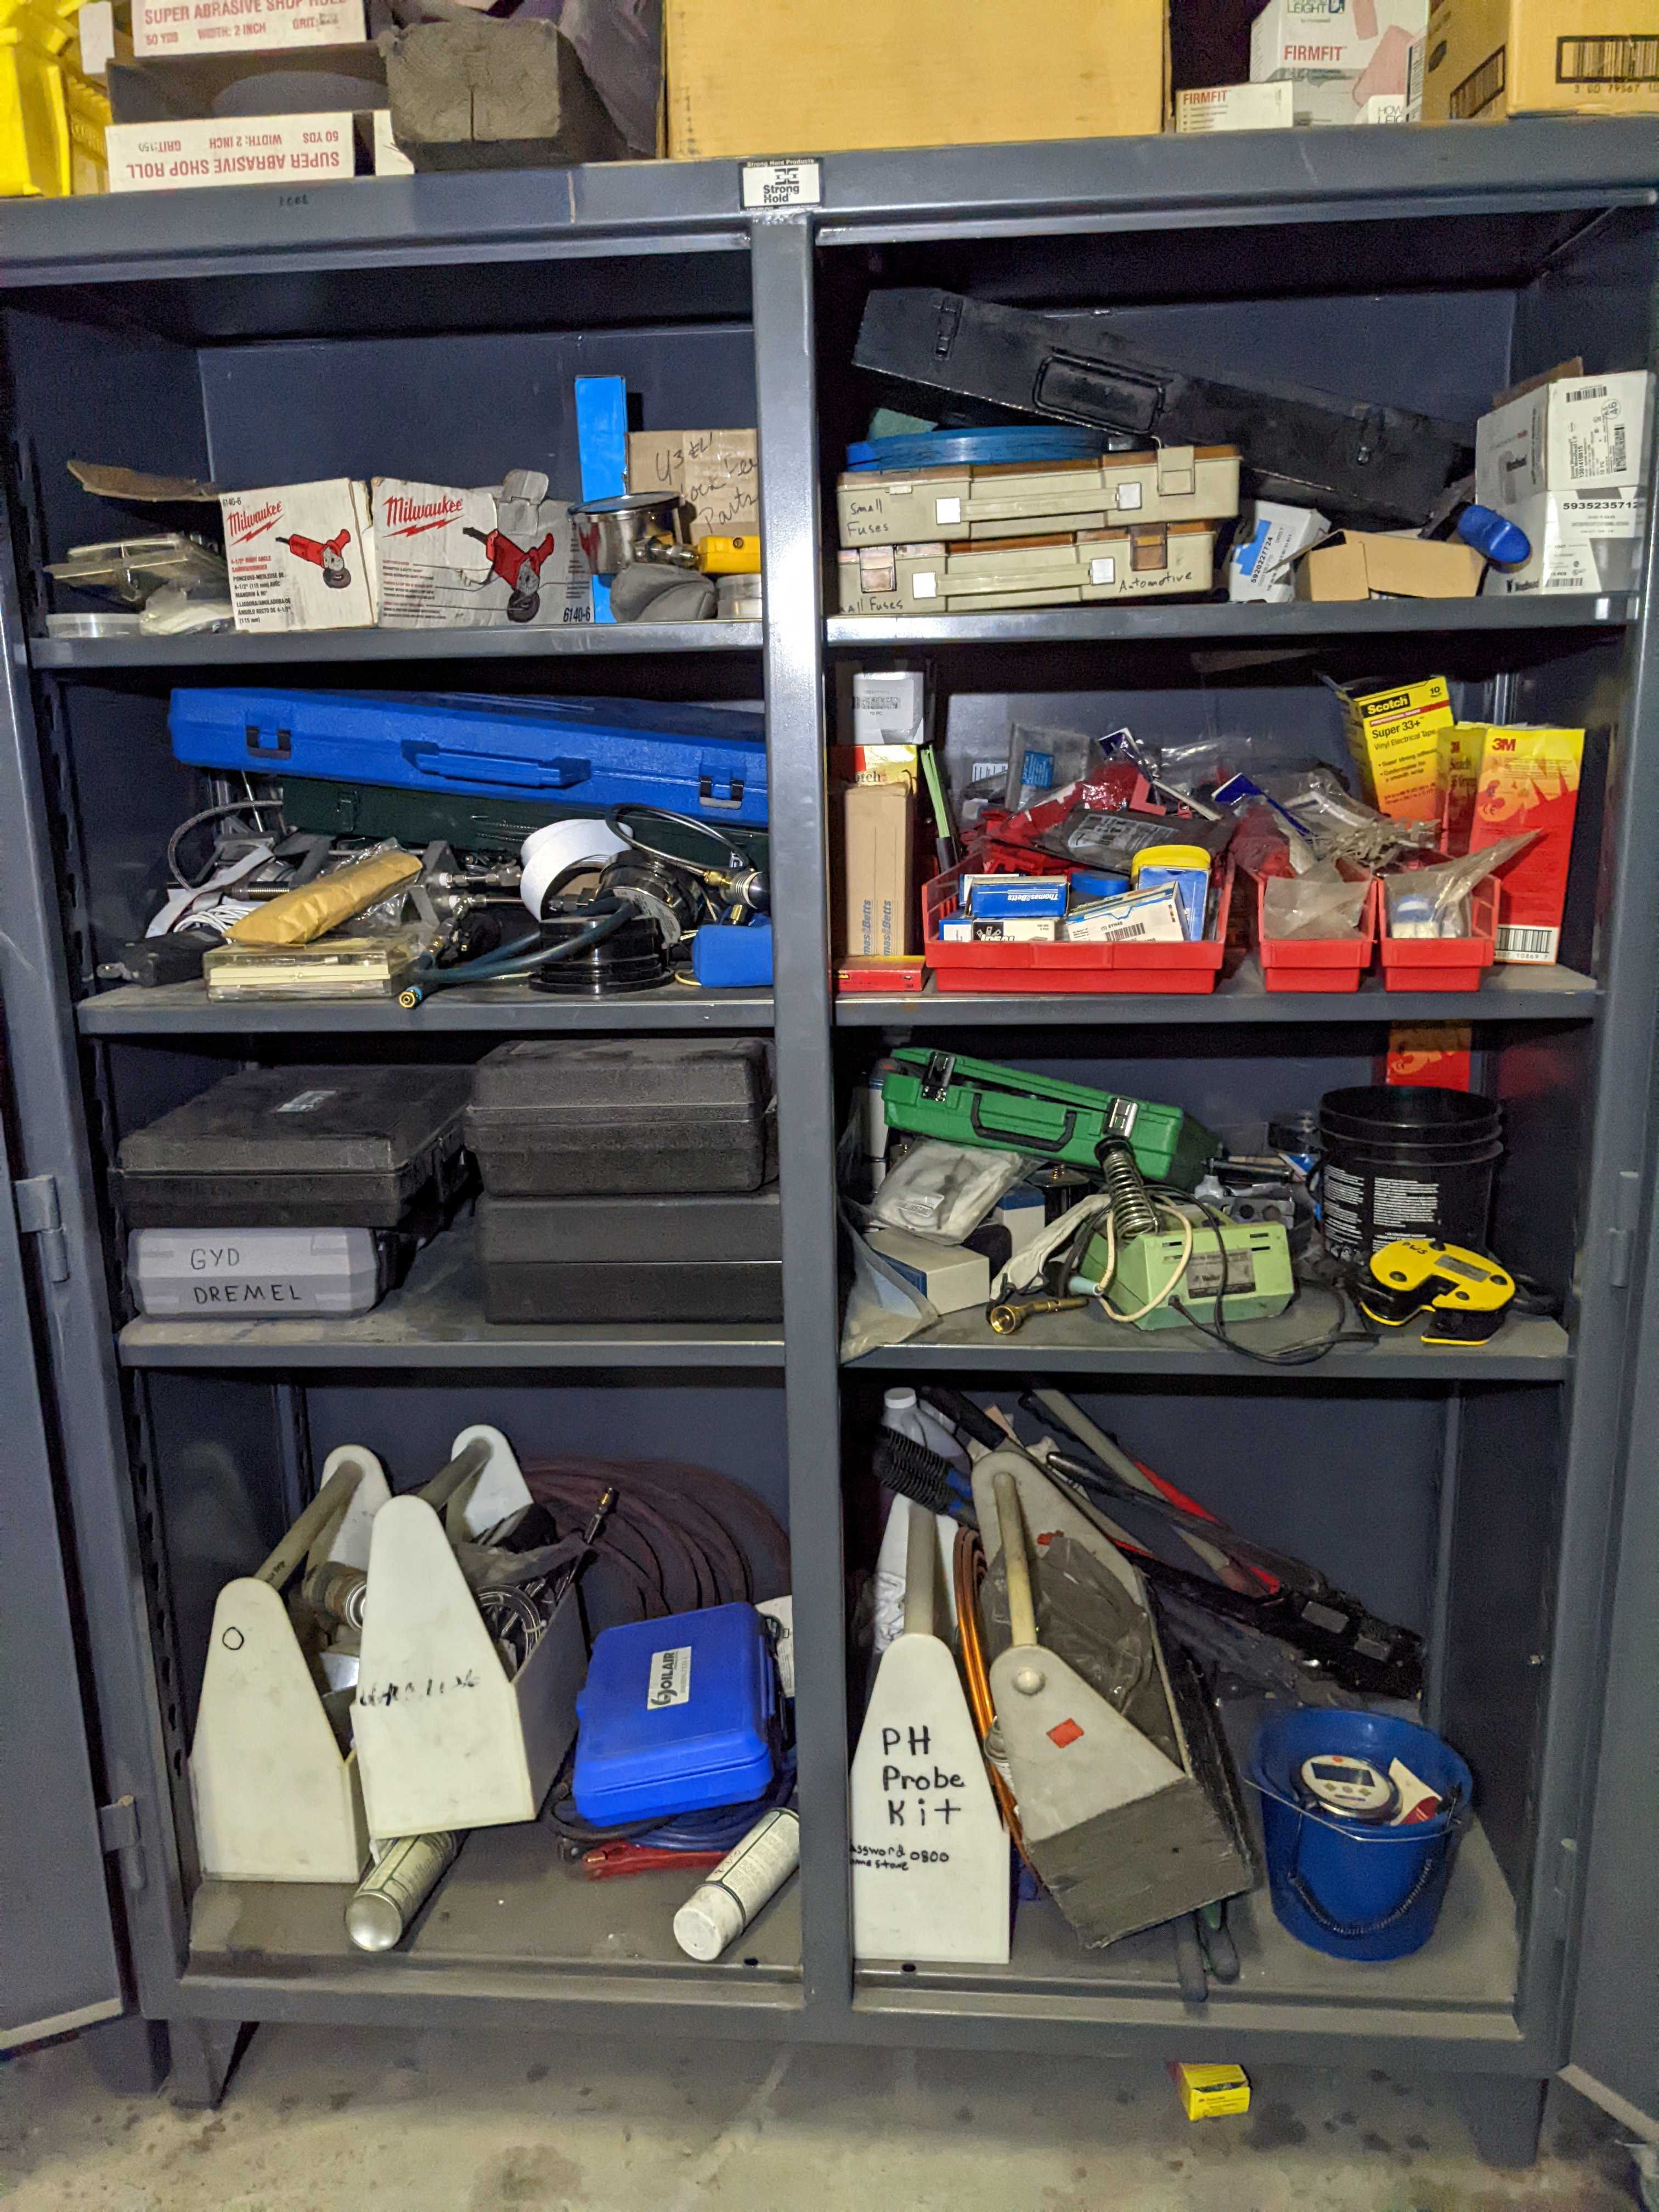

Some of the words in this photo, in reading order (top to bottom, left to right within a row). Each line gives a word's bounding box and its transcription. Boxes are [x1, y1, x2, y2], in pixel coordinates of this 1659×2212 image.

[145, 5, 189, 25] SUPER
[195, 0, 262, 19] ABRASIVE
[234, 26, 240, 36] 2
[243, 23, 266, 35] INCH
[1284, 46, 1343, 61] FIRMFIT
[1183, 90, 1228, 105] FIRMFIT
[210, 138, 233, 149] INCH
[236, 137, 242, 147] 2
[245, 134, 281, 145] WIDTH:
[303, 132, 323, 143] YDS
[326, 131, 338, 142] 50
[170, 159, 210, 176] SHOP
[215, 154, 285, 173] ABRASIVE
[291, 151, 340, 169] SUPER
[127, 163, 165, 179] ROLL
[763, 184, 799, 194] Strong
[764, 194, 789, 204] Hold
[222, 497, 241, 506] 6140-6
[850, 498, 883, 515] Small
[227, 501, 282, 537] Milwaukee
[382, 495, 464, 527] Milwaukee
[847, 521, 889, 536] Fuses
[1119, 571, 1192, 593] Automotive
[870, 597, 903, 611] Fuses
[563, 607, 591, 622] 6140-6
[1367, 696, 1408, 715] Scotch
[1372, 725, 1400, 739] Super
[1402, 720, 1421, 731] 33+
[1374, 742, 1390, 751] Vinyl
[1391, 734, 1421, 746] Electrical
[1421, 729, 1436, 739] Tape
[1492, 737, 1516, 752] 3M
[1402, 1242, 1428, 1255] PWS
[191, 1248, 240, 1271] GYD
[194, 1283, 302, 1304] DREMEL
[882, 1725, 931, 1756] PH
[882, 1765, 966, 1791] Probe
[888, 1798, 961, 1826] Kit
